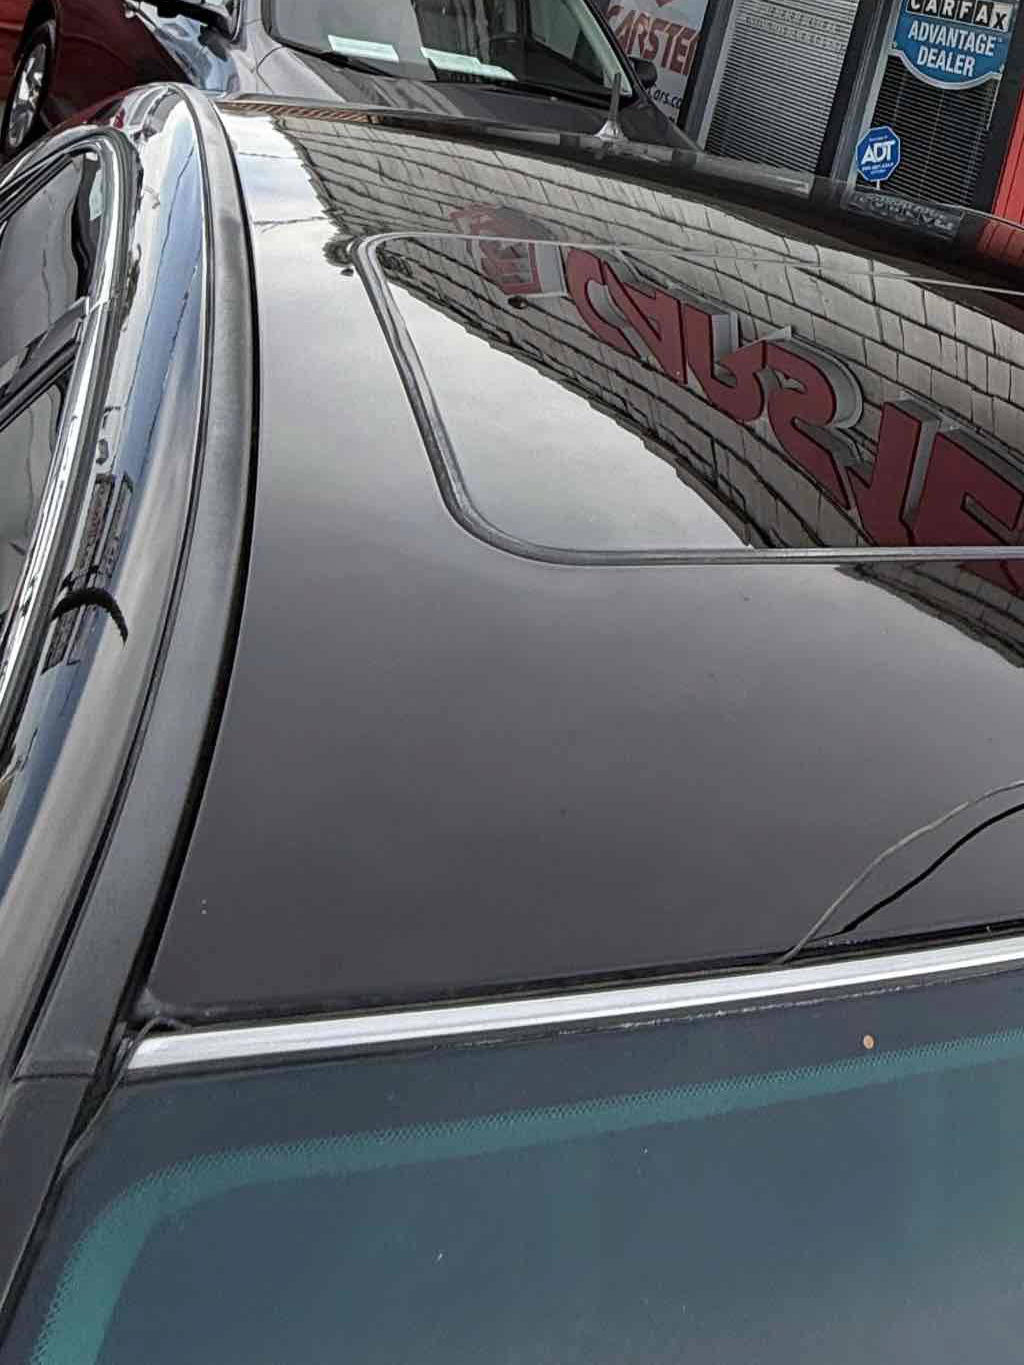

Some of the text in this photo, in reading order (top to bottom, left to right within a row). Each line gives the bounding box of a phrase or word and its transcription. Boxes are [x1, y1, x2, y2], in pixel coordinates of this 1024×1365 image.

[907, 20, 996, 56] ADVANTAGE
[917, 45, 976, 77] DEALER
[861, 140, 896, 164] ADT
